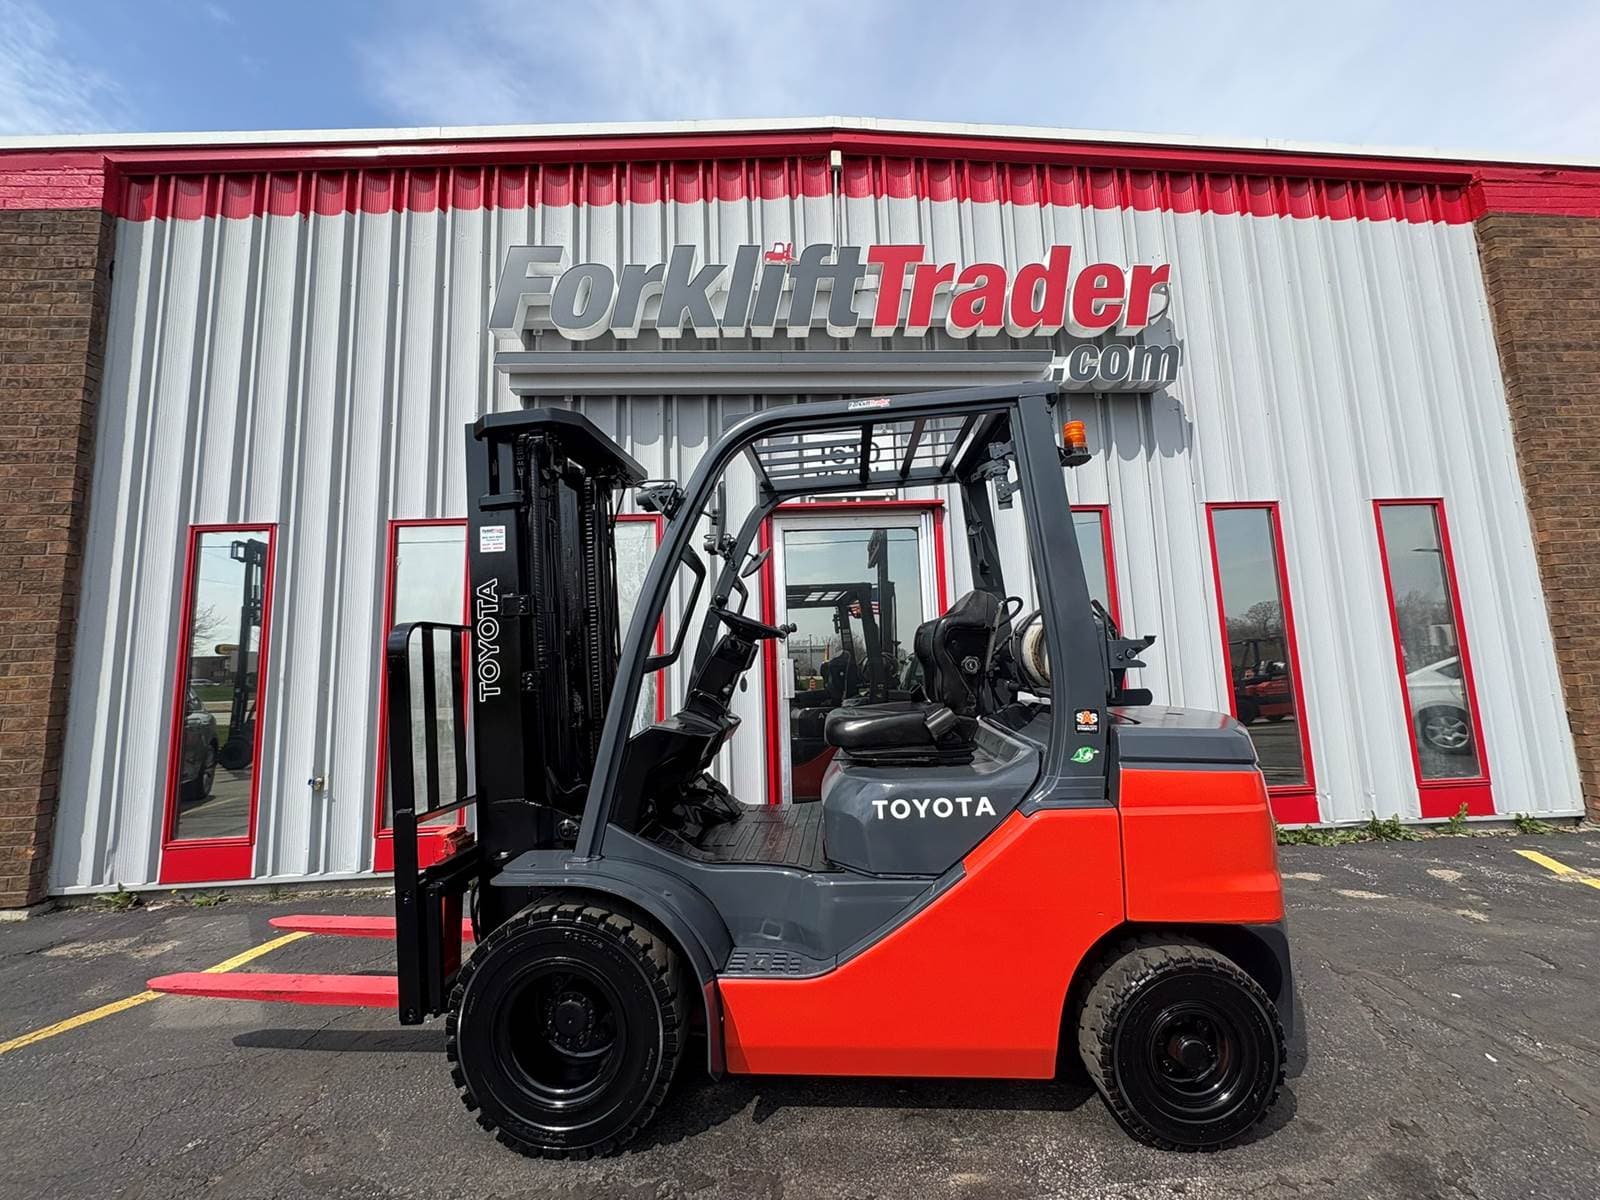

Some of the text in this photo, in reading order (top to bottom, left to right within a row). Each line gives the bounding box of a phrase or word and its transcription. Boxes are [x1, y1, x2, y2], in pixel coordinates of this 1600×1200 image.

[487, 243, 1171, 336] ForkliftTrader
[1051, 344, 1180, 385] .com
[476, 578, 501, 703] TOYOTA
[1075, 710, 1099, 725] SAS
[872, 796, 996, 820] TOYOTA
